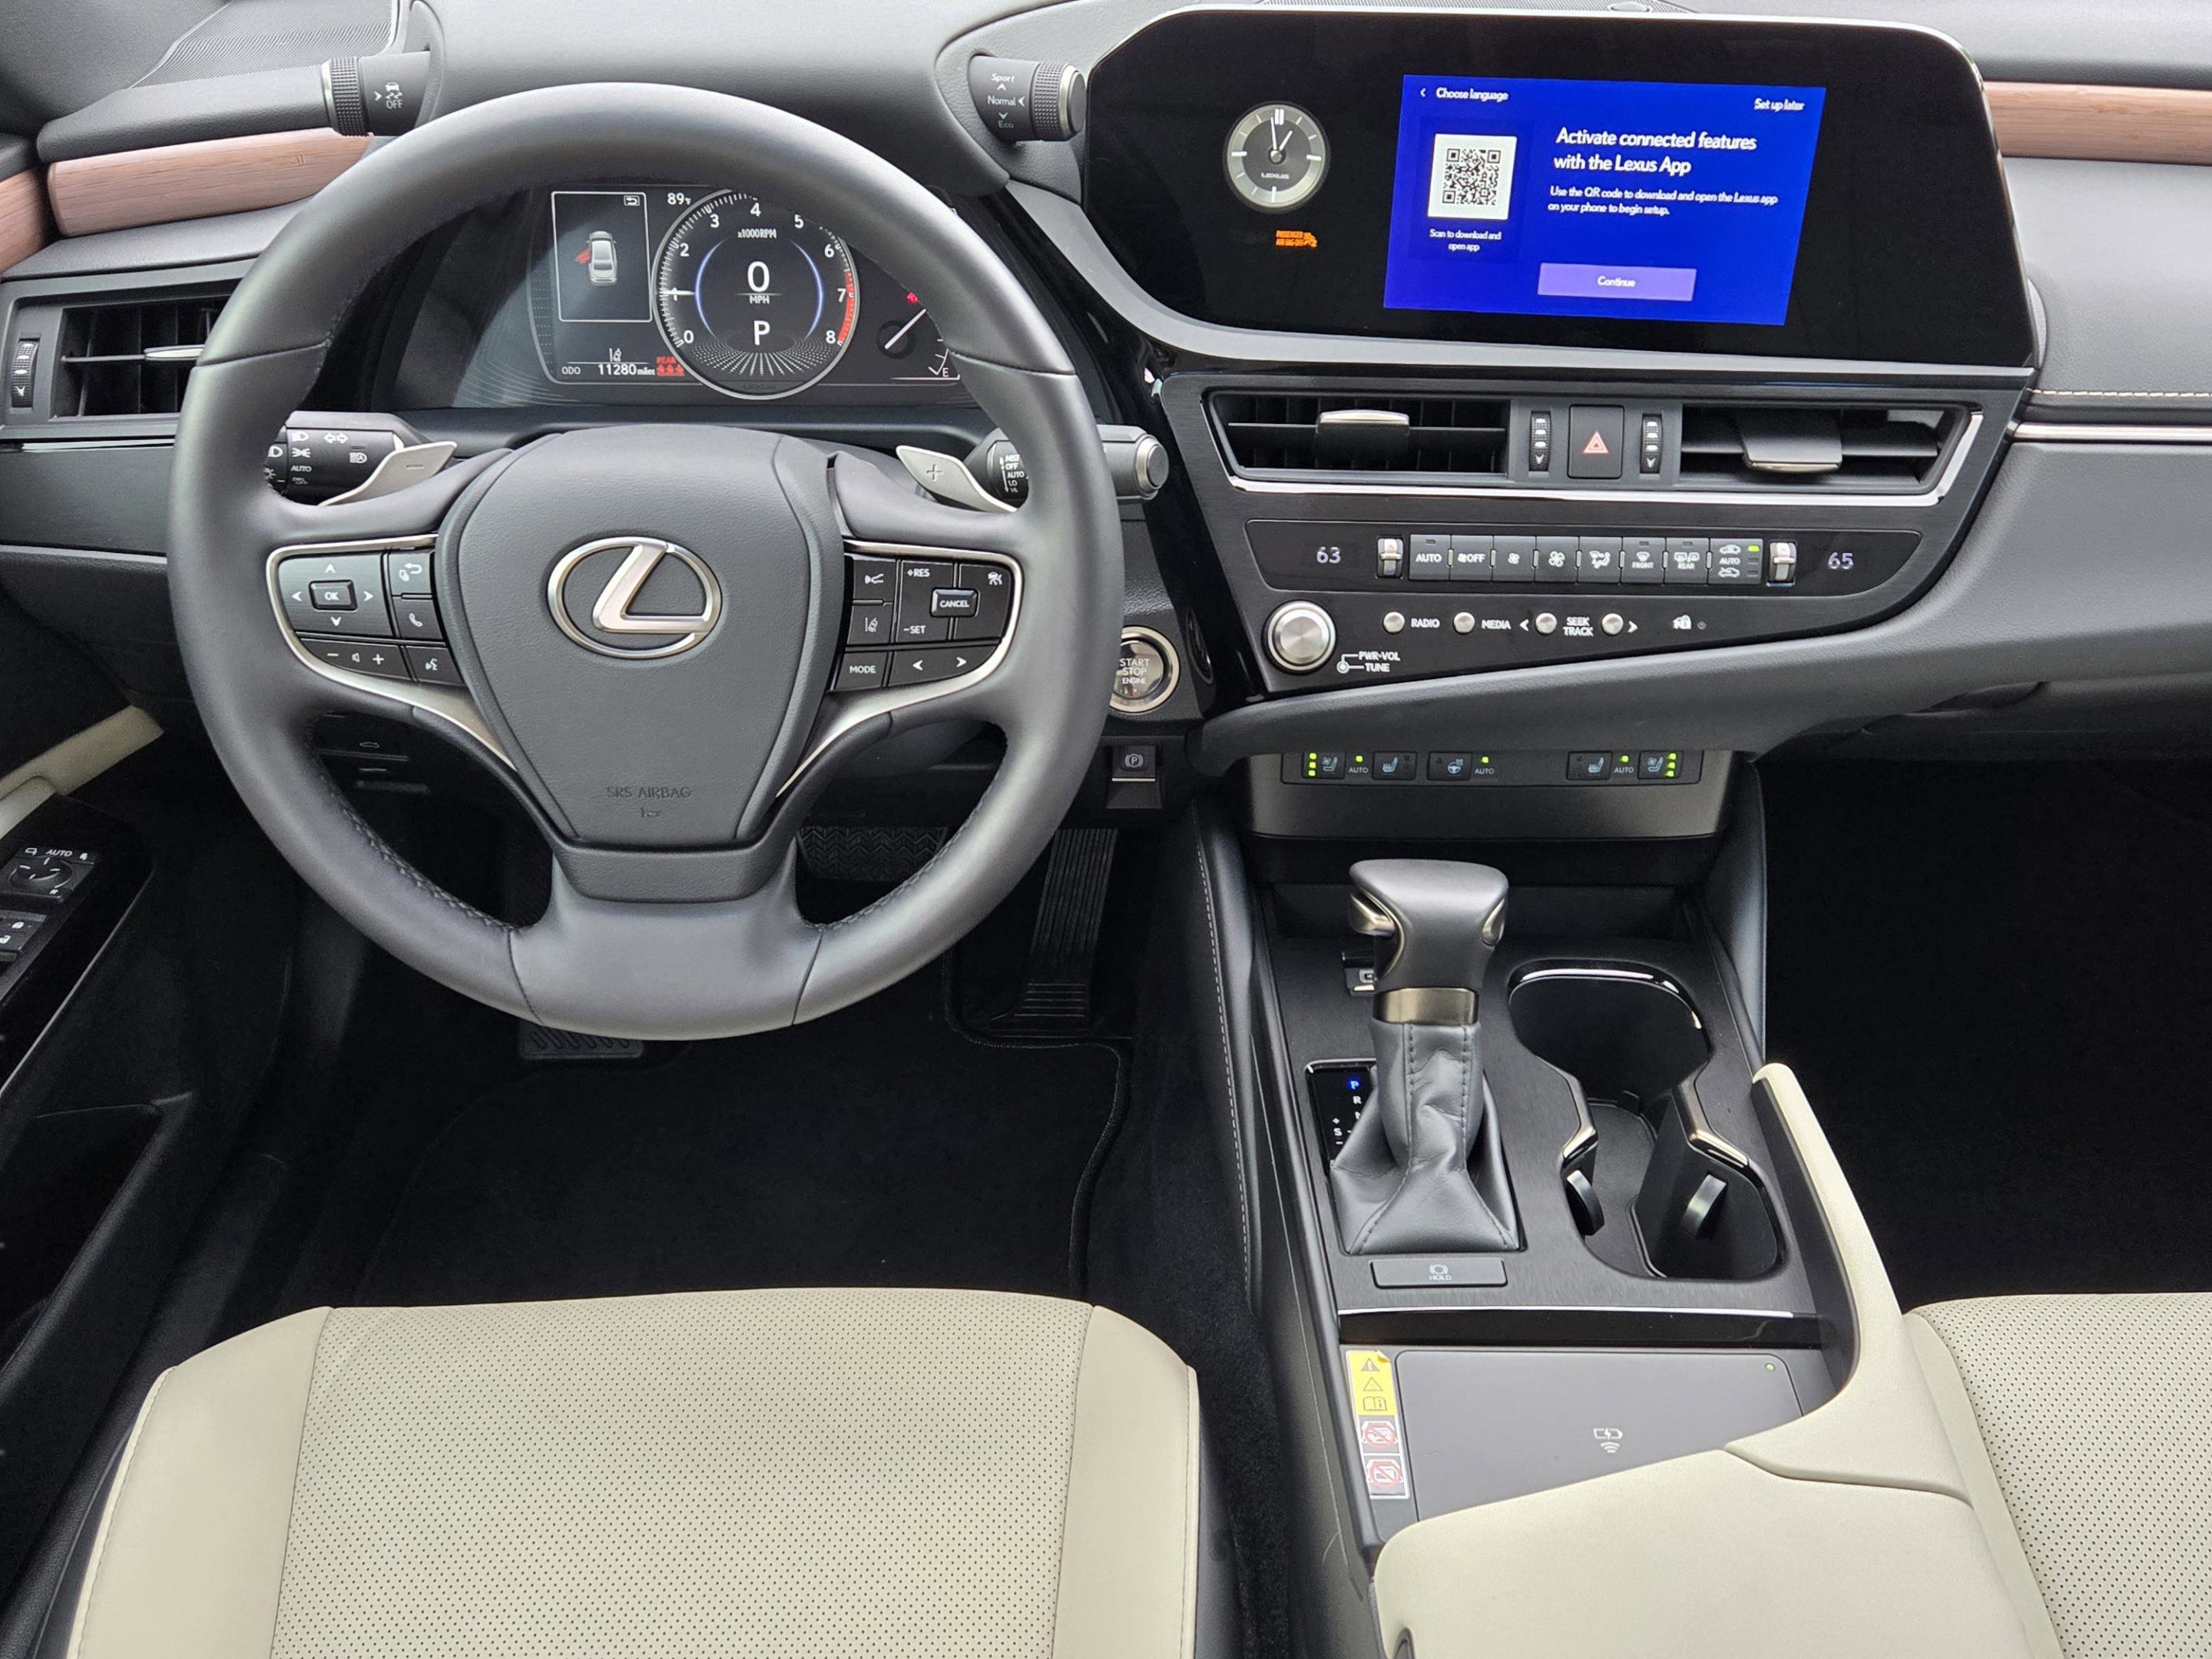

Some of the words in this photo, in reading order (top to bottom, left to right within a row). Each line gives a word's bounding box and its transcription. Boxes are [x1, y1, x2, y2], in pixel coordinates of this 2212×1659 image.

[990, 73, 1015, 82] Sport
[1435, 87, 1469, 99] Choose
[1469, 88, 1508, 102] language
[386, 99, 403, 109] OFF
[988, 95, 1016, 107] Normal
[1753, 98, 1770, 111] Set
[1771, 101, 1783, 112] up
[1783, 99, 1805, 111] later
[998, 120, 1014, 129] Eco
[1555, 127, 1617, 145] Activate
[1619, 131, 1696, 148] connected
[1697, 131, 1757, 150] features
[1553, 154, 1586, 170] with
[1588, 154, 1612, 171] the
[1614, 154, 1657, 172] Lexus
[1659, 155, 1691, 177] App
[1549, 185, 1568, 197] Use
[1568, 187, 1584, 197] the
[1584, 187, 1601, 198] QR
[1601, 188, 1623, 198] code
[1624, 189, 1634, 199] to
[1634, 189, 1677, 200] download
[1677, 190, 1694, 200] and
[1694, 193, 1717, 204] open
[1717, 190, 1733, 203] the
[1733, 192, 1760, 204] Lexus
[1760, 194, 1779, 206] app
[750, 203, 762, 217] 4
[1548, 203, 1560, 211] on
[1560, 203, 1580, 213] your
[1580, 202, 1607, 214] phone
[1608, 203, 1618, 212] to
[1618, 203, 1644, 216] begin
[710, 214, 720, 228] 3
[794, 214, 804, 229] 5
[679, 243, 690, 257] 2
[824, 243, 835, 258] 6
[747, 260, 770, 293] 0
[1597, 275, 1636, 287] Continue
[749, 295, 770, 304] MPH
[837, 288, 846, 303] 7
[683, 329, 694, 344] 0
[753, 320, 770, 346] P
[826, 330, 836, 344] 8
[561, 366, 581, 375] ODO
[598, 363, 637, 376] 11280
[942, 367, 949, 378] E
[1316, 546, 1342, 564] 63
[1415, 552, 1442, 563] AUTO
[1466, 553, 1486, 563] OFF
[1827, 551, 1854, 570] 65
[1719, 557, 1740, 565] AUTO
[324, 591, 339, 601] OK
[939, 599, 970, 608] CANCEL
[1410, 618, 1440, 628] RADIO
[1481, 618, 1511, 630] MEDIA
[1566, 616, 1590, 627] SEEK
[1563, 626, 1594, 637] TRACK
[1119, 658, 1151, 667] START
[1365, 662, 1391, 673] TUNE
[849, 665, 876, 674] MODE
[1122, 667, 1147, 676] STOP
[1121, 677, 1147, 685] ENGINE
[1349, 766, 1369, 774] AUTO
[1475, 767, 1495, 775] AUTO
[1614, 766, 1634, 774] AUTO
[607, 786, 633, 798] SRS
[637, 786, 692, 799] AIRBAG
[45, 849, 73, 857] AUTO
[1350, 1080, 1360, 1090] P
[1353, 1095, 1362, 1104] R
[1333, 1128, 1343, 1136] S
